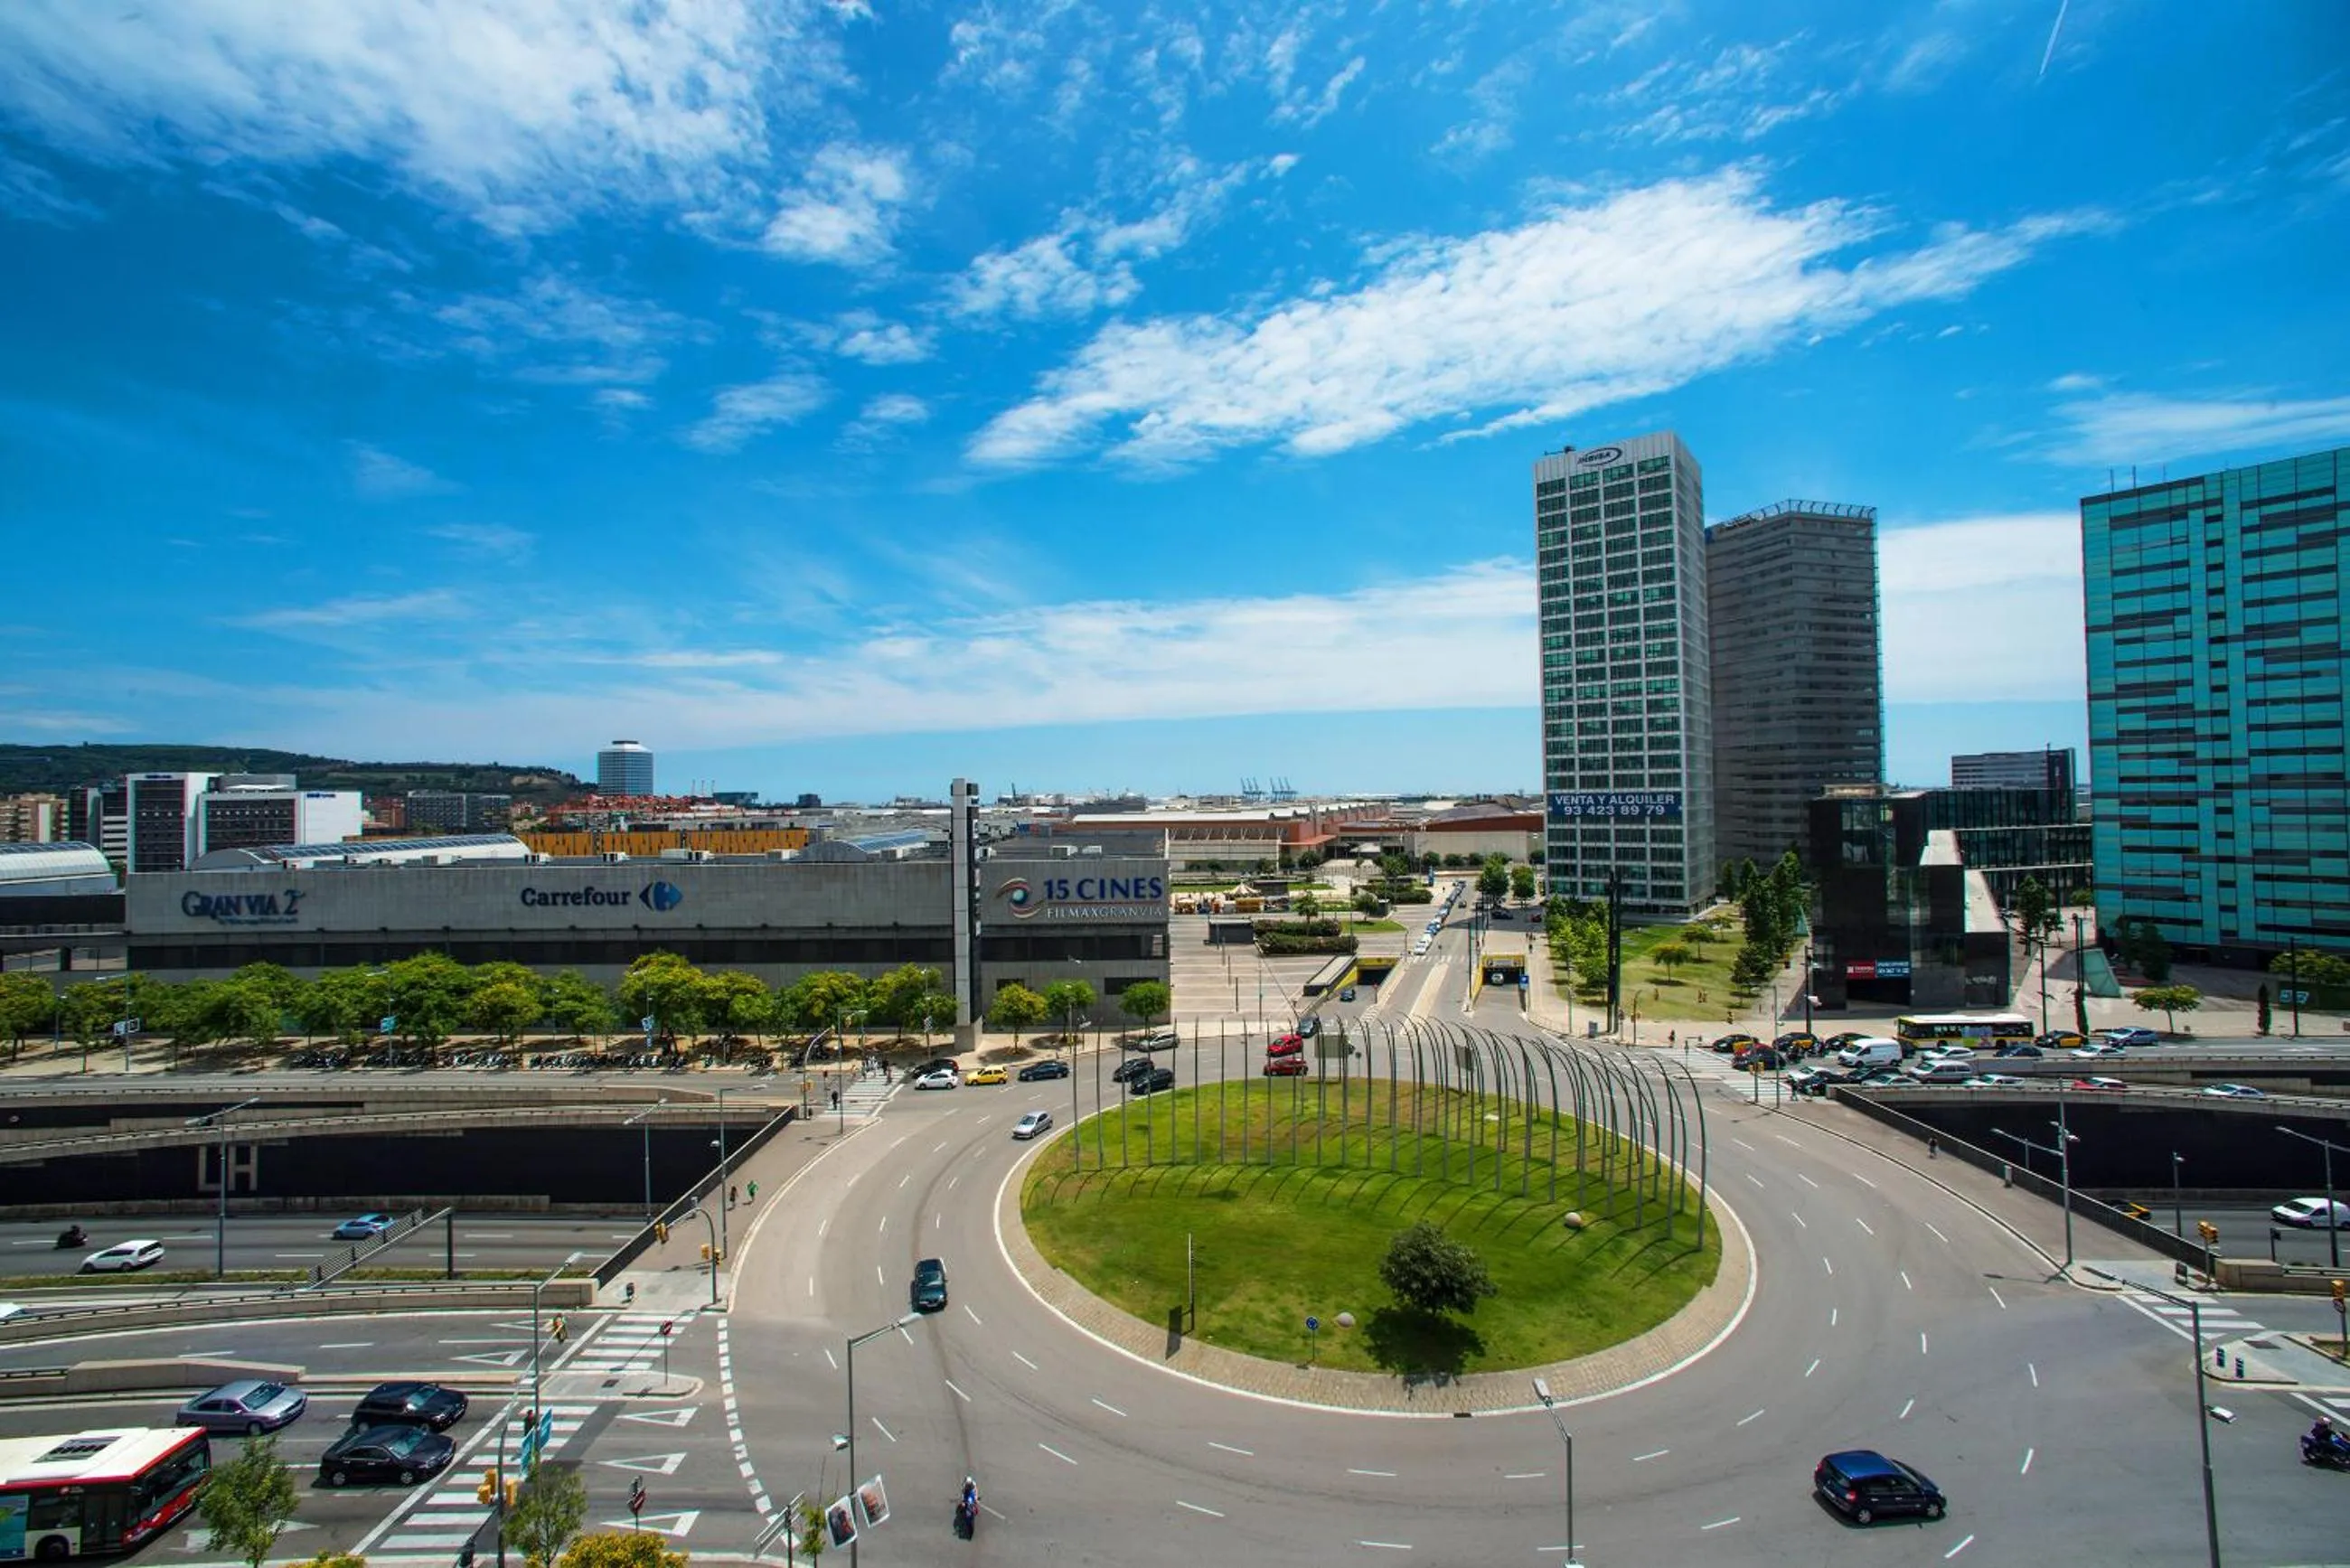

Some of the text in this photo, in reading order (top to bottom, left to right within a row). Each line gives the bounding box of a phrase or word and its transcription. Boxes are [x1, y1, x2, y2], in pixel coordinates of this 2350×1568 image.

[1555, 794, 1675, 805] VENTA Y ALQUILER
[1564, 805, 1582, 815] 93
[1586, 805, 1614, 815] 423
[1645, 805, 1665, 815] 79
[521, 887, 631, 906] Carrefour
[1044, 877, 1163, 900] 15 CINES
[182, 889, 306, 920] GRAN VIA 2
